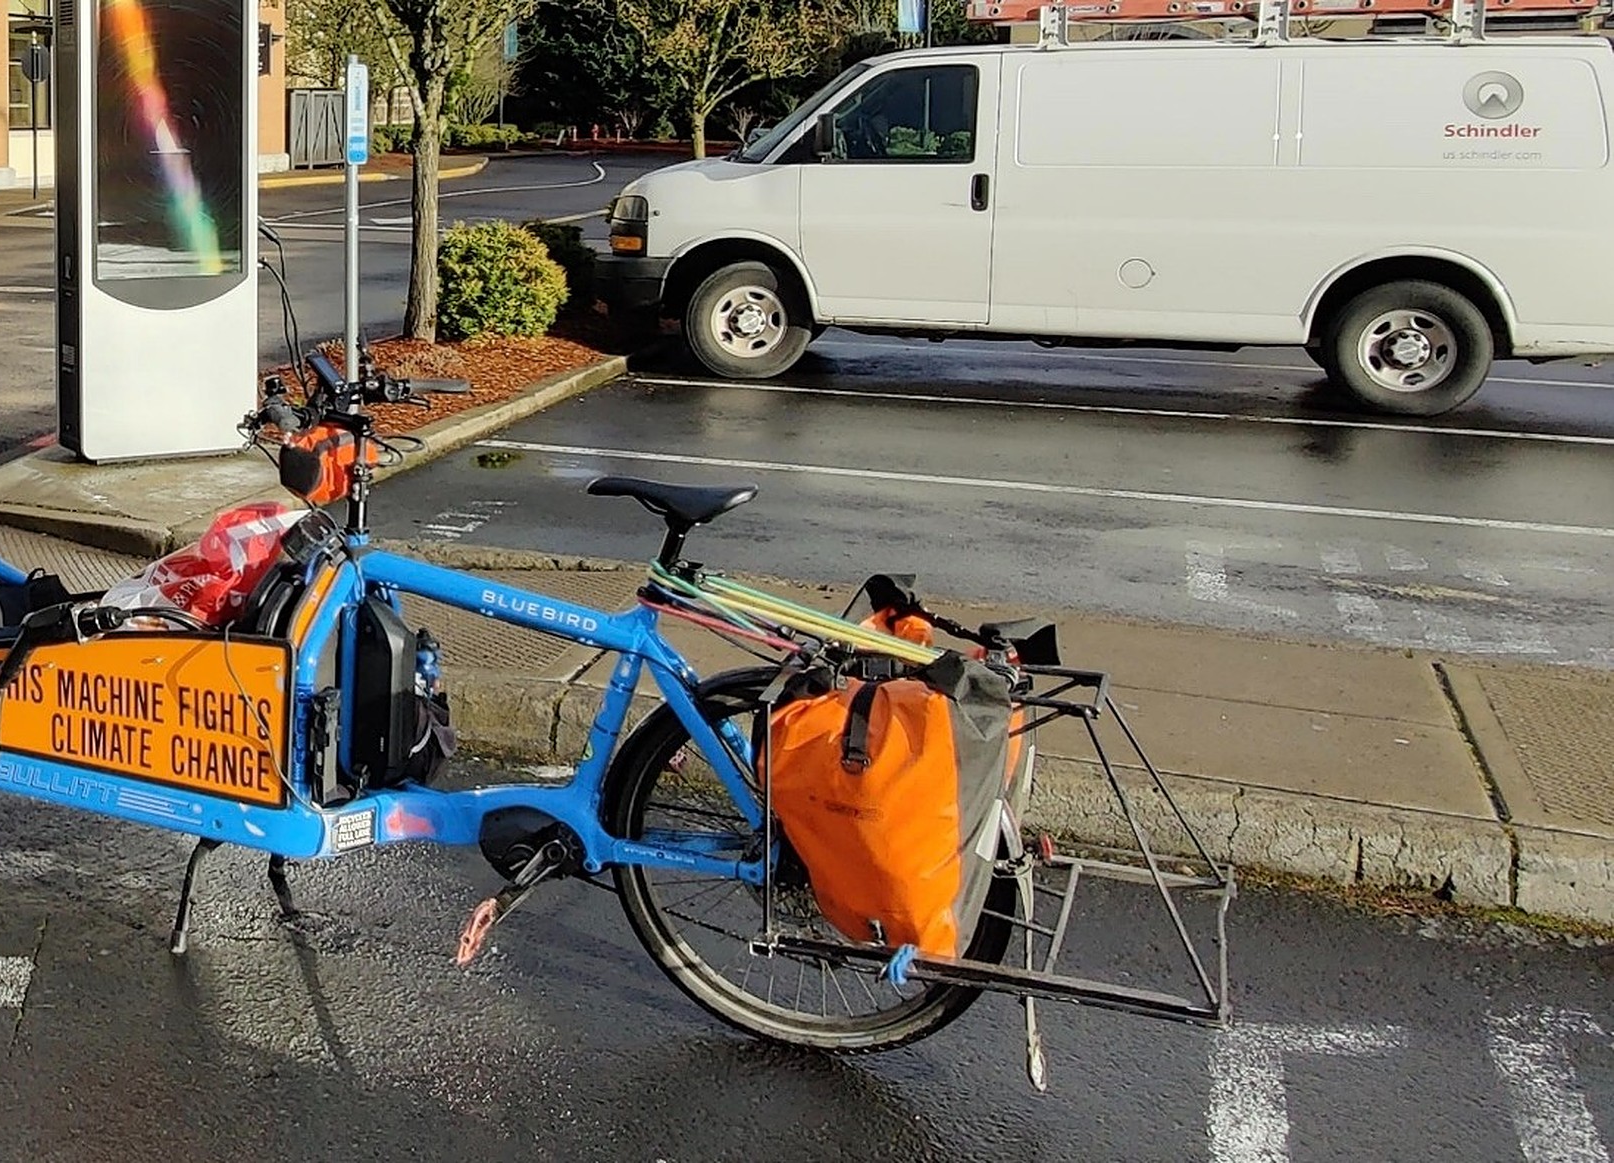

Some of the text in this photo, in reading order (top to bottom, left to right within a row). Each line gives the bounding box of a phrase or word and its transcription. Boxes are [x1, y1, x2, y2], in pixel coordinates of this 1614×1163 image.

[1444, 125, 1541, 138] Schindler
[482, 590, 597, 631] BLUEBIRD
[57, 668, 164, 723] MACHINE
[178, 686, 272, 741] FIGHTS
[51, 713, 152, 768] CLIMATE
[171, 735, 270, 793] CHANGE
